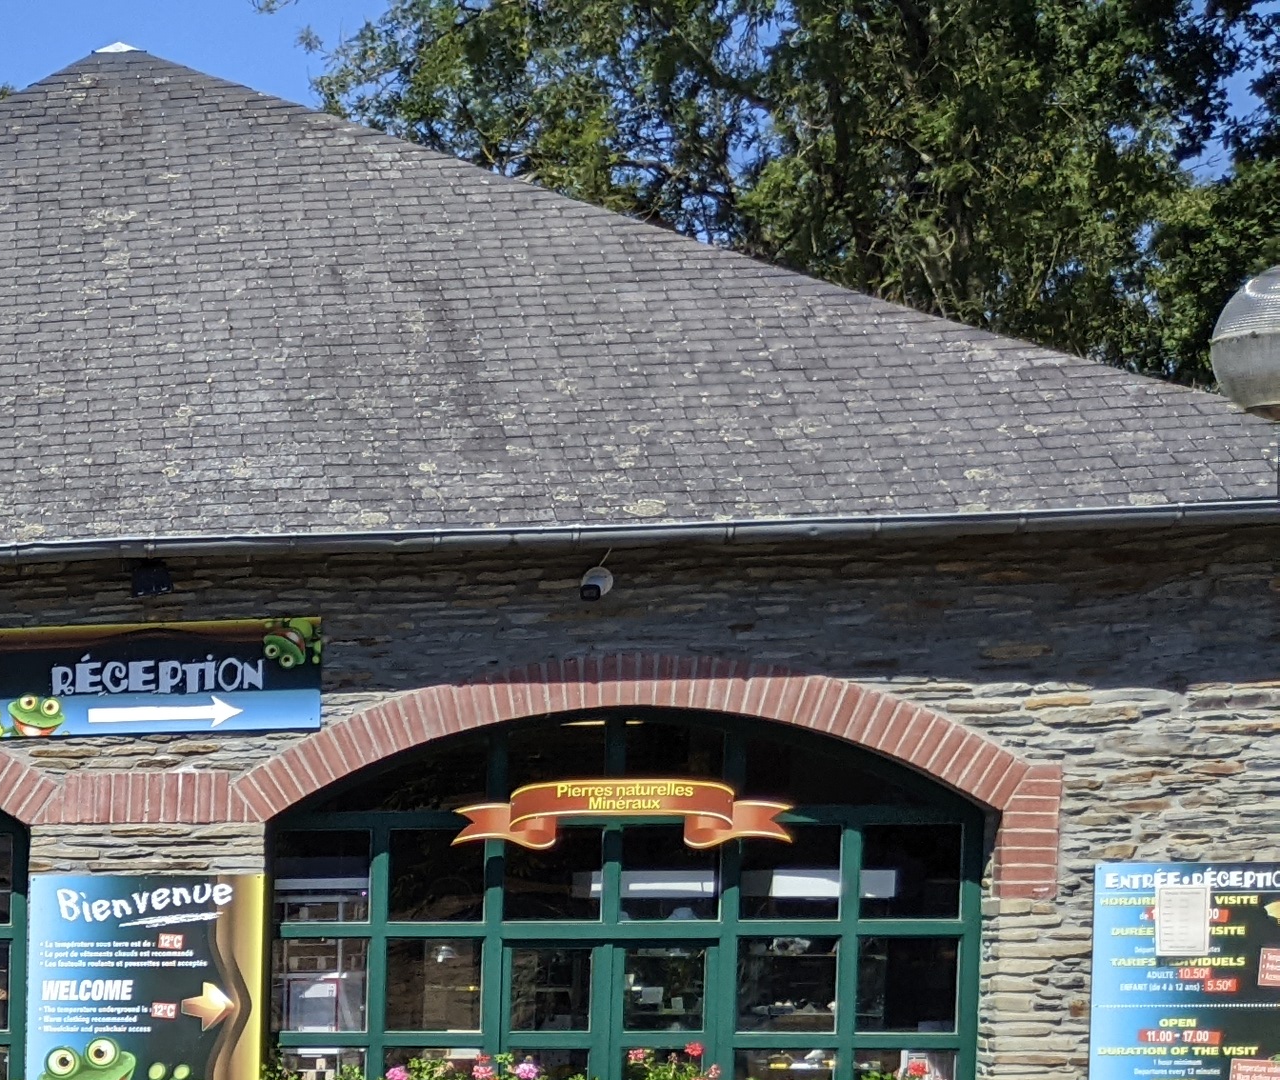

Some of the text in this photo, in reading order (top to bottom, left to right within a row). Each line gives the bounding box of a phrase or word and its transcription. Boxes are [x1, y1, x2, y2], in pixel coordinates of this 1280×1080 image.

[51, 654, 263, 696] RÉCEPTION
[556, 783, 694, 798] Pierres naturelles
[588, 797, 660, 810] Minéraux
[1105, 868, 1180, 889] ENTRÉE
[56, 883, 233, 922] Bienvenue
[1214, 895, 1258, 904] VISITE
[1146, 970, 1173, 979] ADULTE
[41, 979, 134, 1001] WELCOME
[1159, 1018, 1197, 1027] OPEN
[1146, 1030, 1172, 1042] 11.00
[1183, 1030, 1209, 1042] 17.00
[1097, 1046, 1258, 1055] DURATION OF THE VISIT
